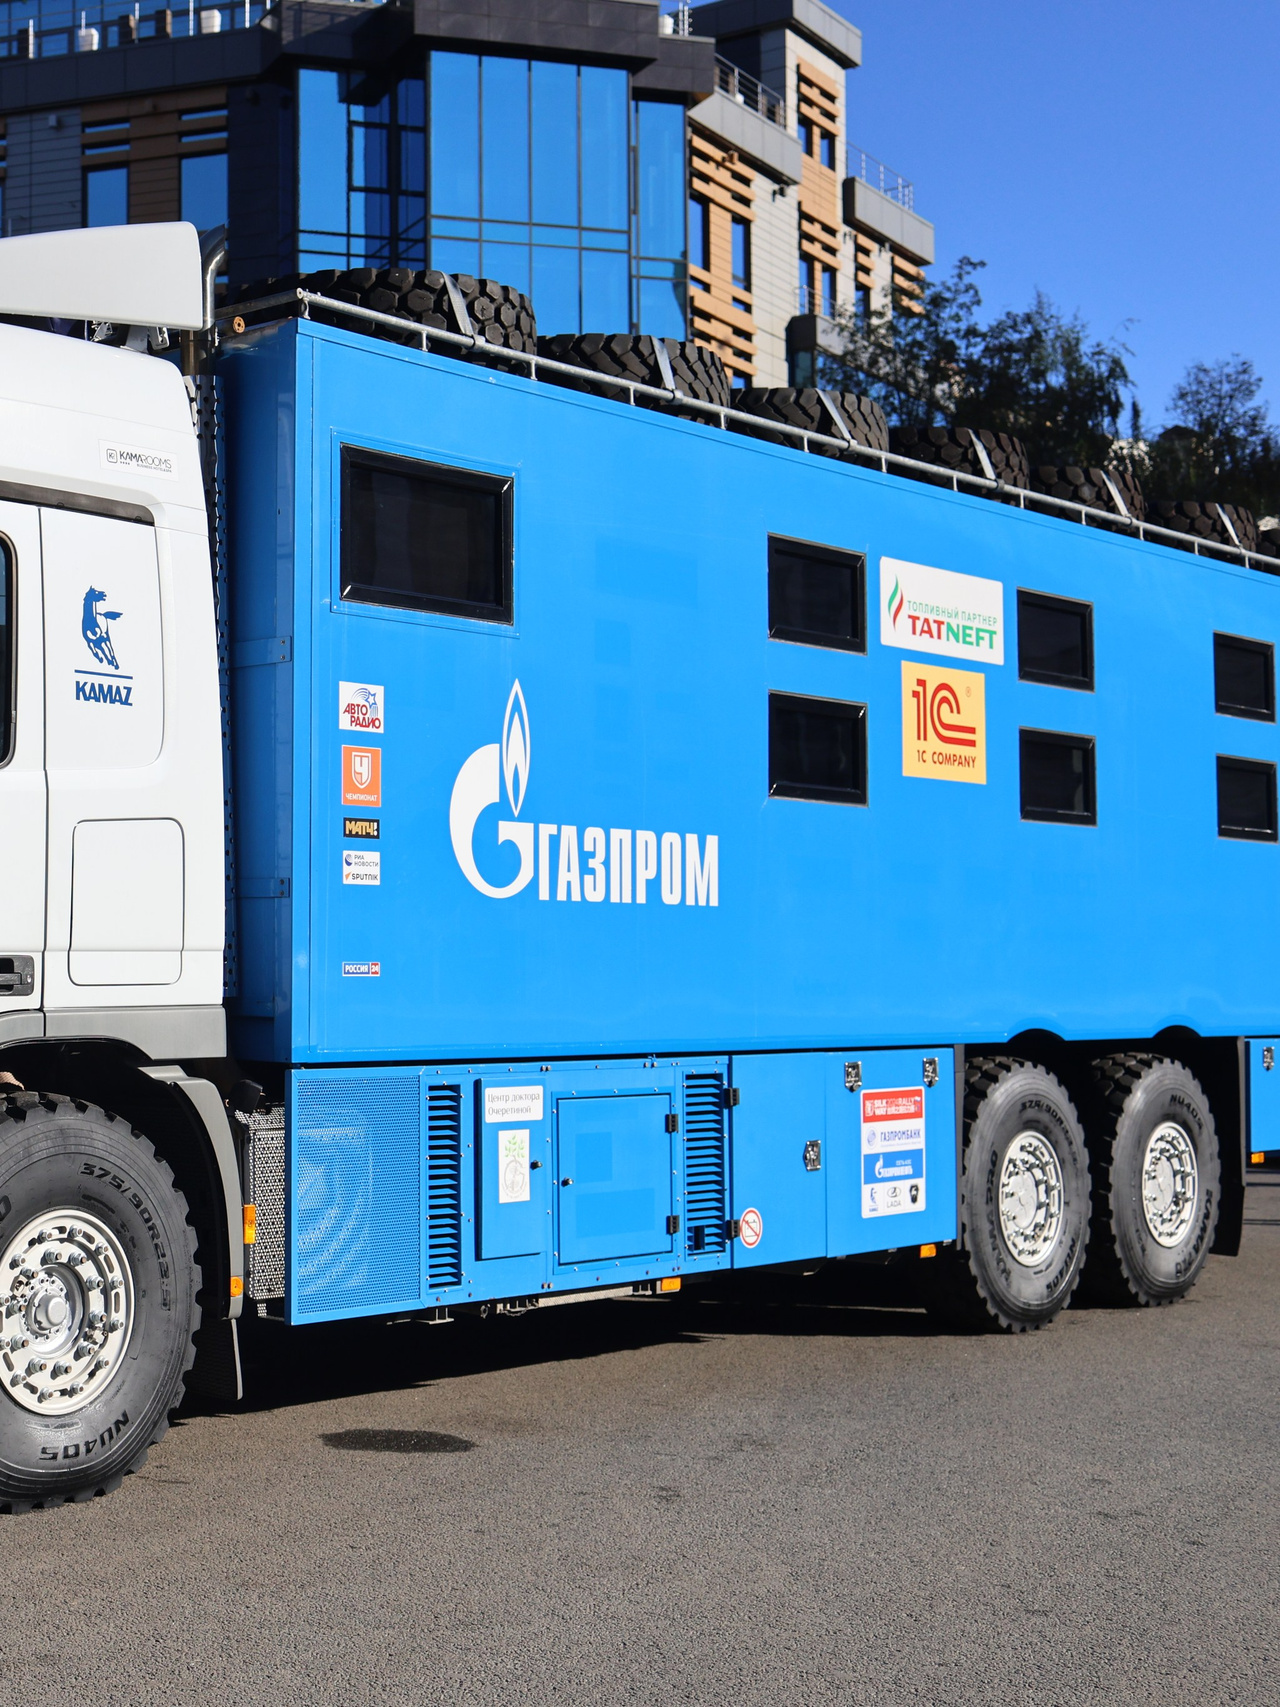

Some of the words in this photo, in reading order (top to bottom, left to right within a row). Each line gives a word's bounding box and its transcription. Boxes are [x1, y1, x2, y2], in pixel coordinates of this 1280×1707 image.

[119, 450, 172, 469] KAMAROOMS
[907, 600, 960, 619] ТОПЛИВНЫЙ
[961, 610, 998, 626] ПАРТНЕР
[908, 614, 997, 650] TATNEFT
[75, 680, 133, 707] KAMAZ
[343, 703, 368, 716] АВТО
[350, 715, 381, 729] РАДИО
[932, 751, 977, 768] COMPANY
[345, 820, 378, 836] МАТЧ!
[538, 822, 719, 907] ГАЗПРОМ
[351, 873, 379, 881] SPUTNIK
[345, 964, 369, 973] РОССИЯ
[371, 964, 380, 973] 24
[488, 1093, 510, 1103] Центр
[511, 1092, 540, 1102] доктора
[80, 1162, 171, 1312] 375/90R22.5
[39, 1409, 130, 1461] NU405
